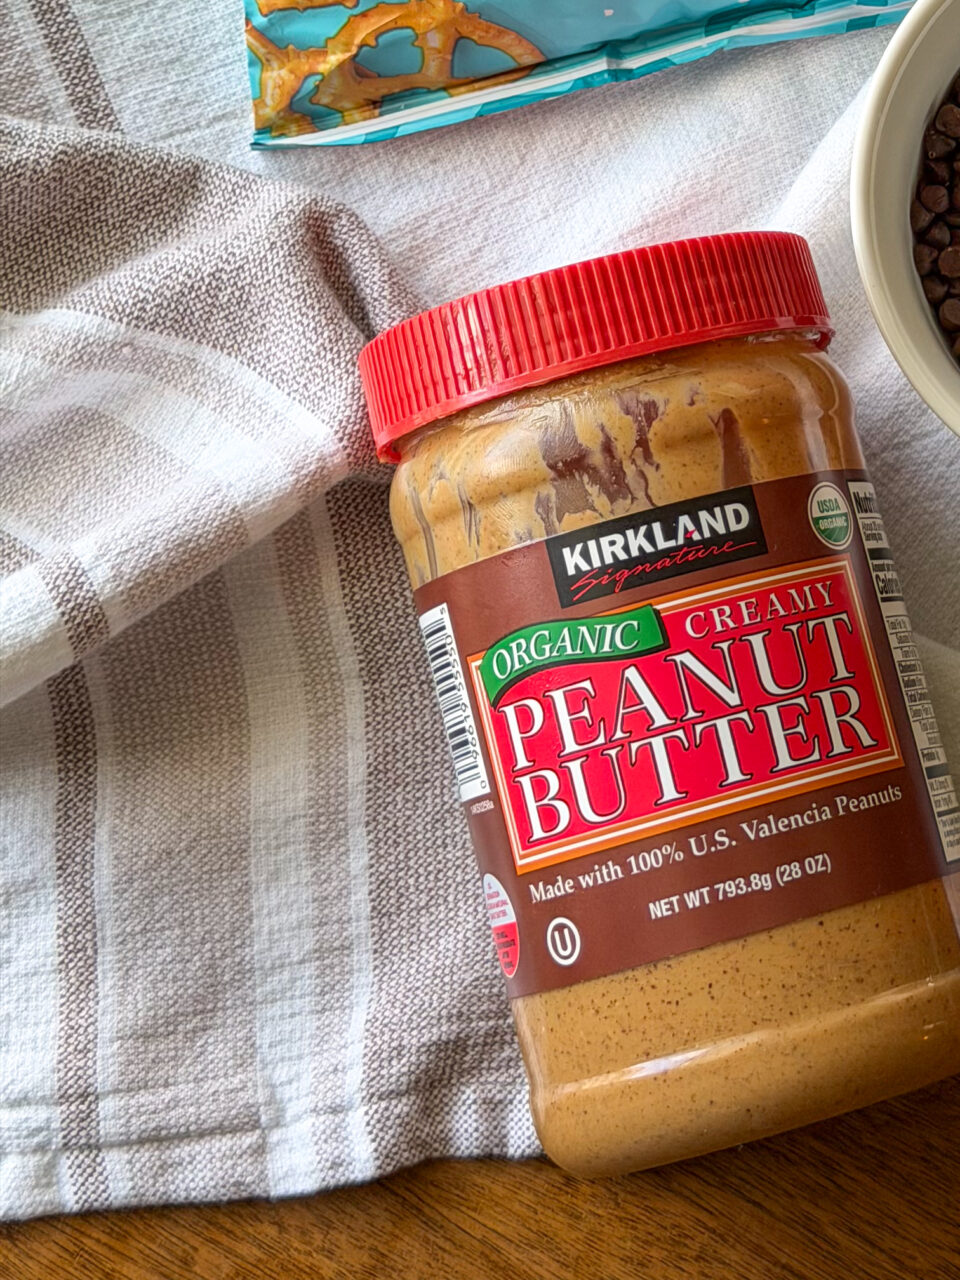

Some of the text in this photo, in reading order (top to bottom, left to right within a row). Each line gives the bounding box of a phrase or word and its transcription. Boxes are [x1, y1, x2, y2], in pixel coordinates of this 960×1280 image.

[817, 498, 841, 513] USDA
[819, 515, 848, 530] ORGANIC
[562, 502, 751, 576] KIRKLAND
[570, 541, 757, 601] Signature
[685, 581, 835, 639] CREAMY
[492, 620, 642, 681] ORGANIC
[497, 612, 857, 774] PEANUT
[514, 684, 879, 844] BUTTER
[529, 875, 575, 904] Made
[578, 860, 625, 890] with
[626, 841, 684, 876] 100%
[689, 828, 737, 857] U.S.
[739, 802, 832, 842] Valencia
[833, 784, 903, 817] Peanuts
[648, 852, 832, 920] NET WT 793.8g (28 OZ)
